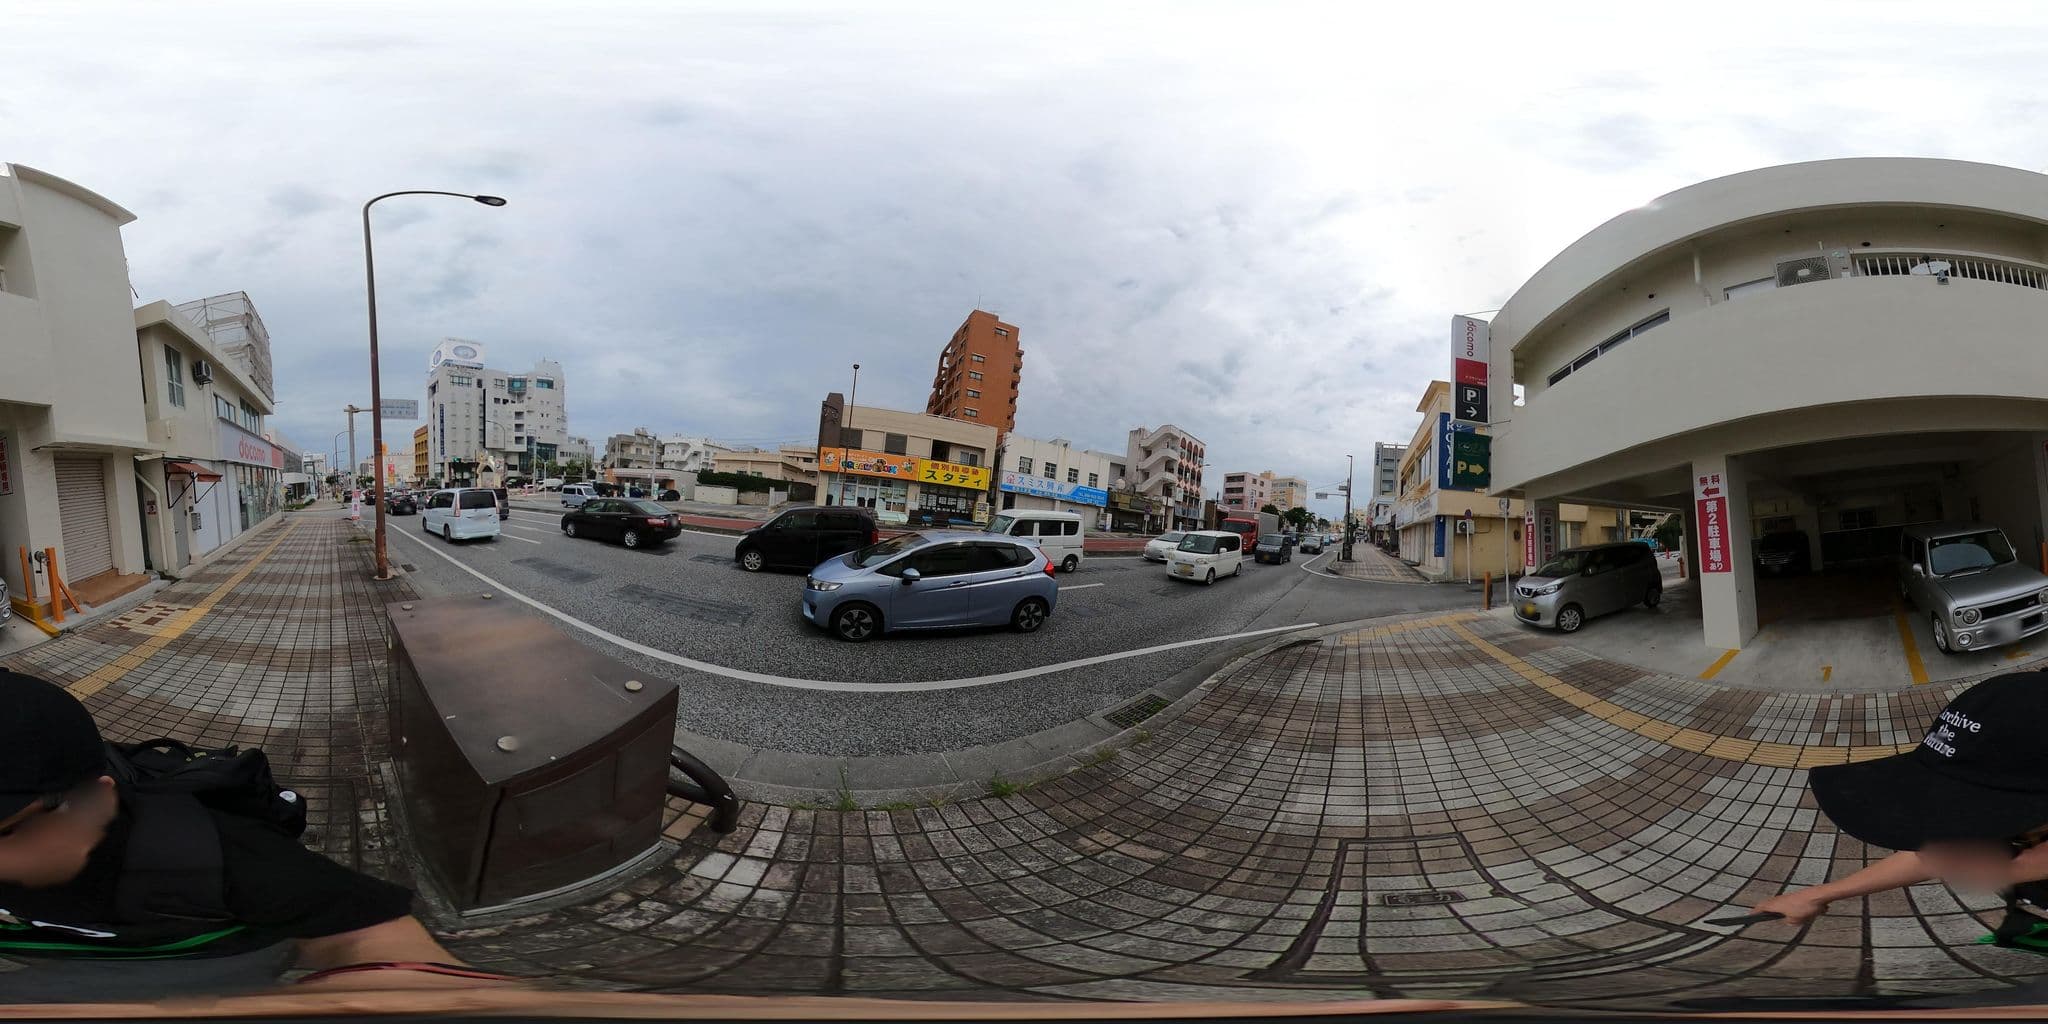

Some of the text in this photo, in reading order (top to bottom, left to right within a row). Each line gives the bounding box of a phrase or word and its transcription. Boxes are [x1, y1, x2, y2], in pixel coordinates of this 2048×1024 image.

[1467, 320, 1476, 357] docomo
[1466, 389, 1476, 401] P
[239, 434, 265, 463] docomo
[1457, 460, 1467, 474] P
[925, 470, 982, 487] スタディ
[1699, 474, 1720, 486] 無料
[1938, 724, 1955, 741] the
